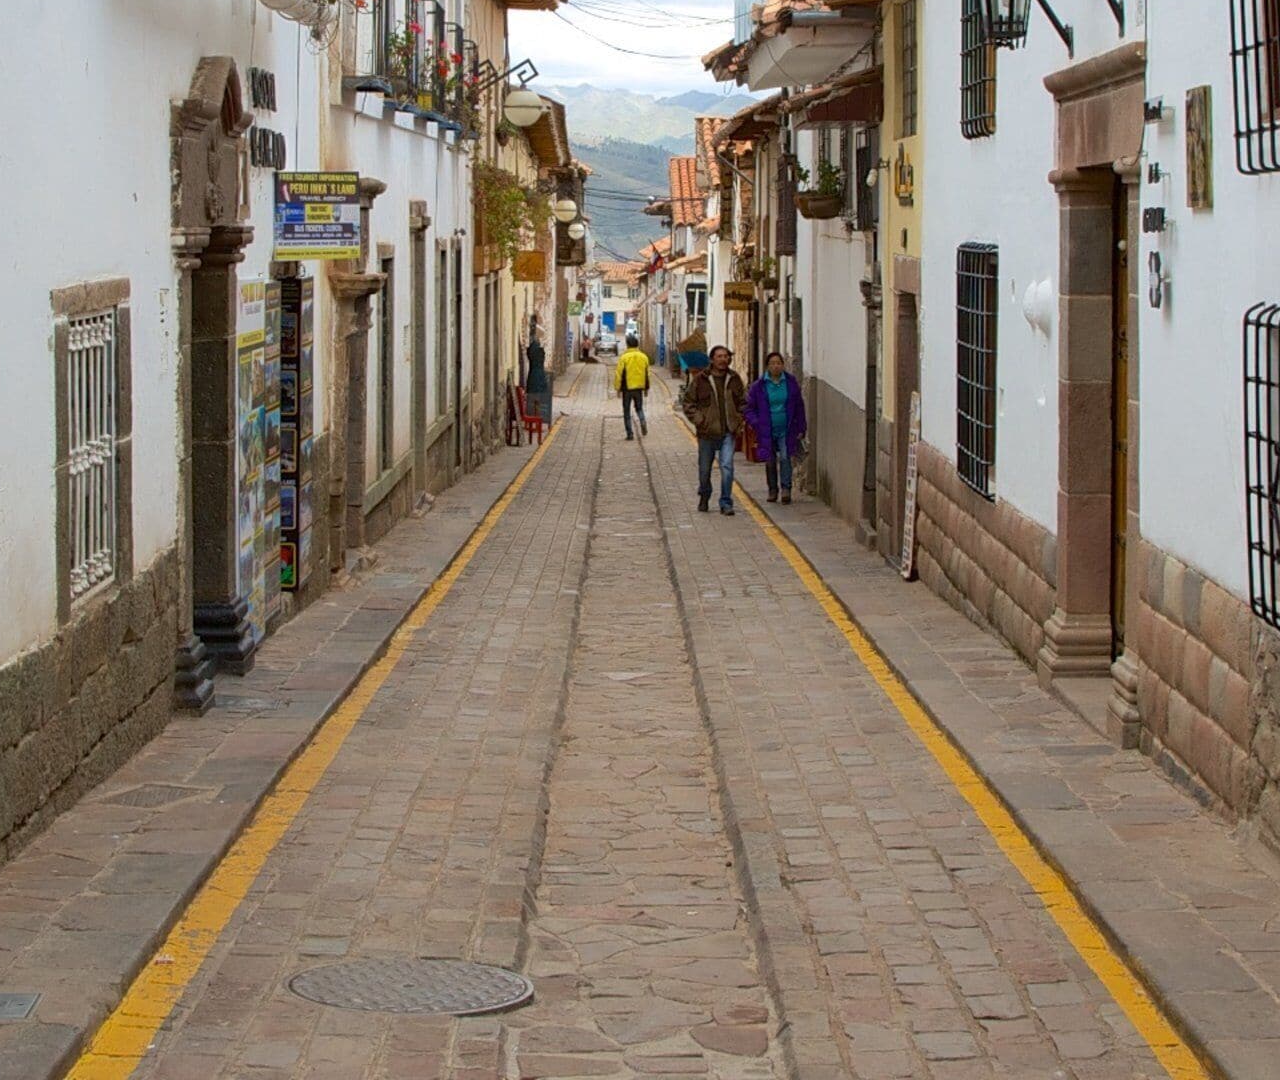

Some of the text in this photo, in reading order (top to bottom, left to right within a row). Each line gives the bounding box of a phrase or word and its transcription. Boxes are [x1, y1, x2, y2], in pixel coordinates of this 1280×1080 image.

[294, 173, 318, 181] TOURIST
[319, 173, 358, 181] INFORMATION
[289, 183, 309, 194] PERU
[337, 183, 356, 195] LAND
